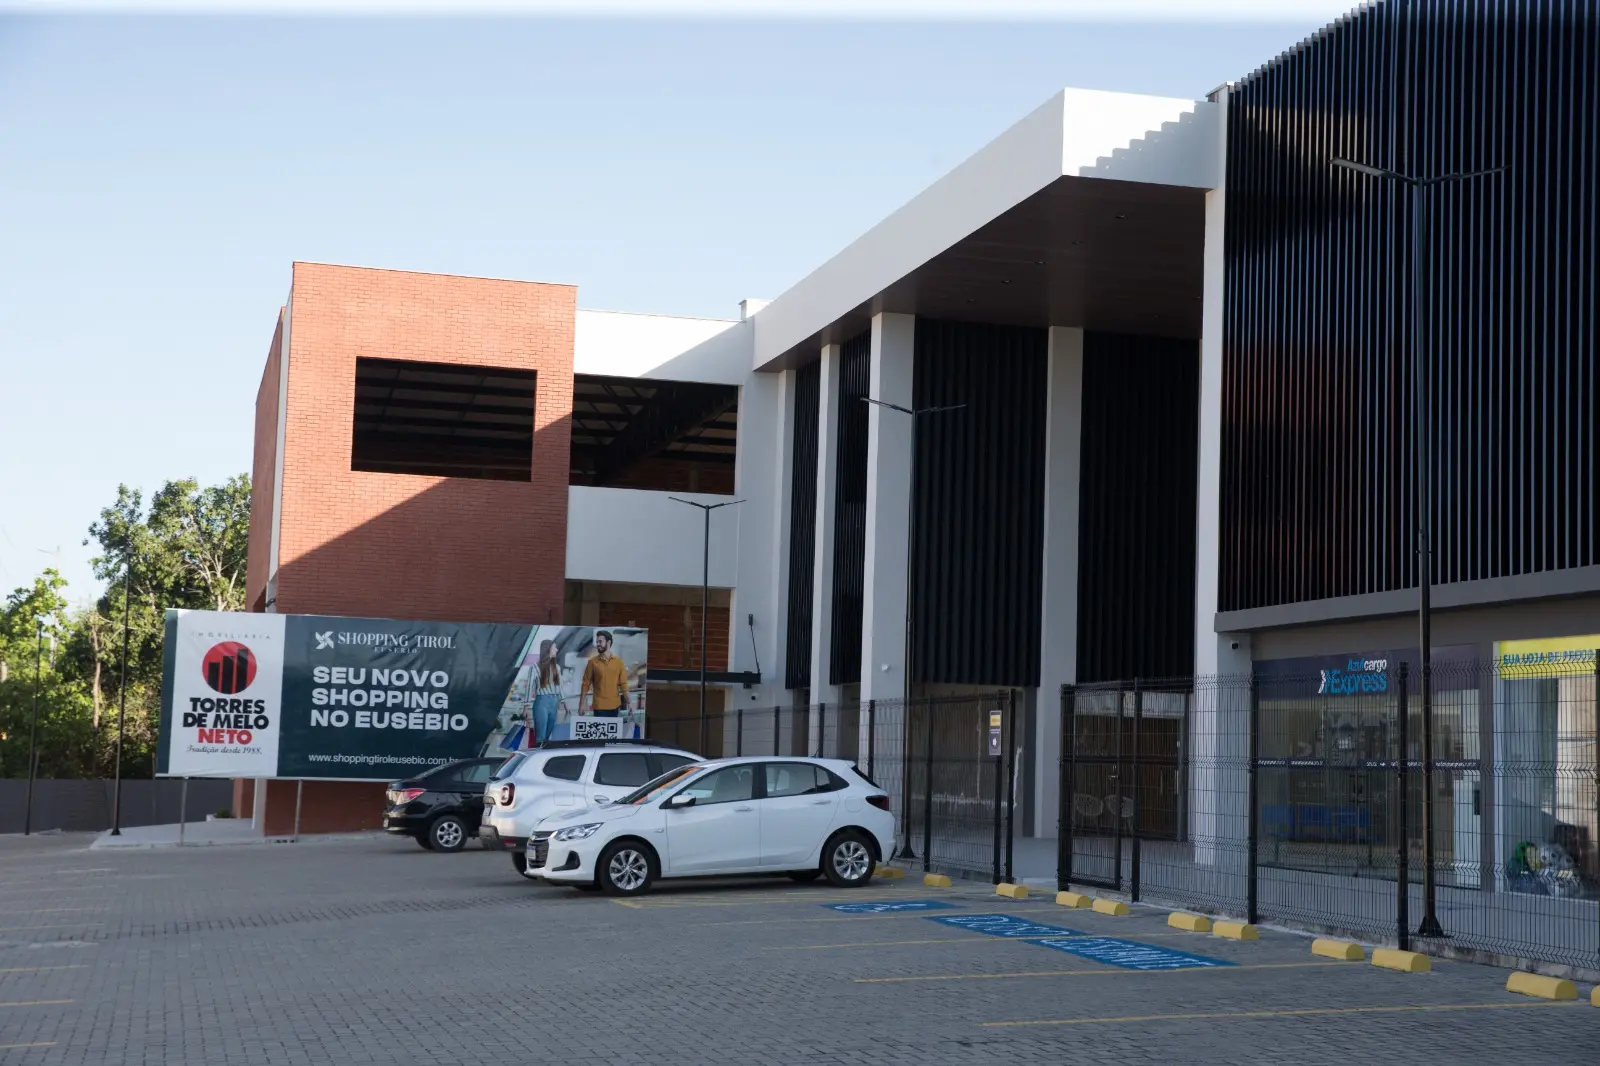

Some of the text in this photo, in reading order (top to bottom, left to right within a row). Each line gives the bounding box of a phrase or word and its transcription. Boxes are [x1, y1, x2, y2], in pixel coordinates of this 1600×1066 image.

[337, 631, 456, 649] SHOPPING TIROL
[1503, 653, 1520, 665] SUA
[312, 666, 449, 688] SEU NOVO
[189, 697, 265, 714] TORRES
[311, 688, 449, 709] SHOPPING
[182, 712, 269, 730] DE MELO
[310, 708, 469, 731] NO EUSÉBIO
[198, 728, 253, 745] NETO
[308, 753, 459, 766] www.shoppingtiroleusebio.comb
